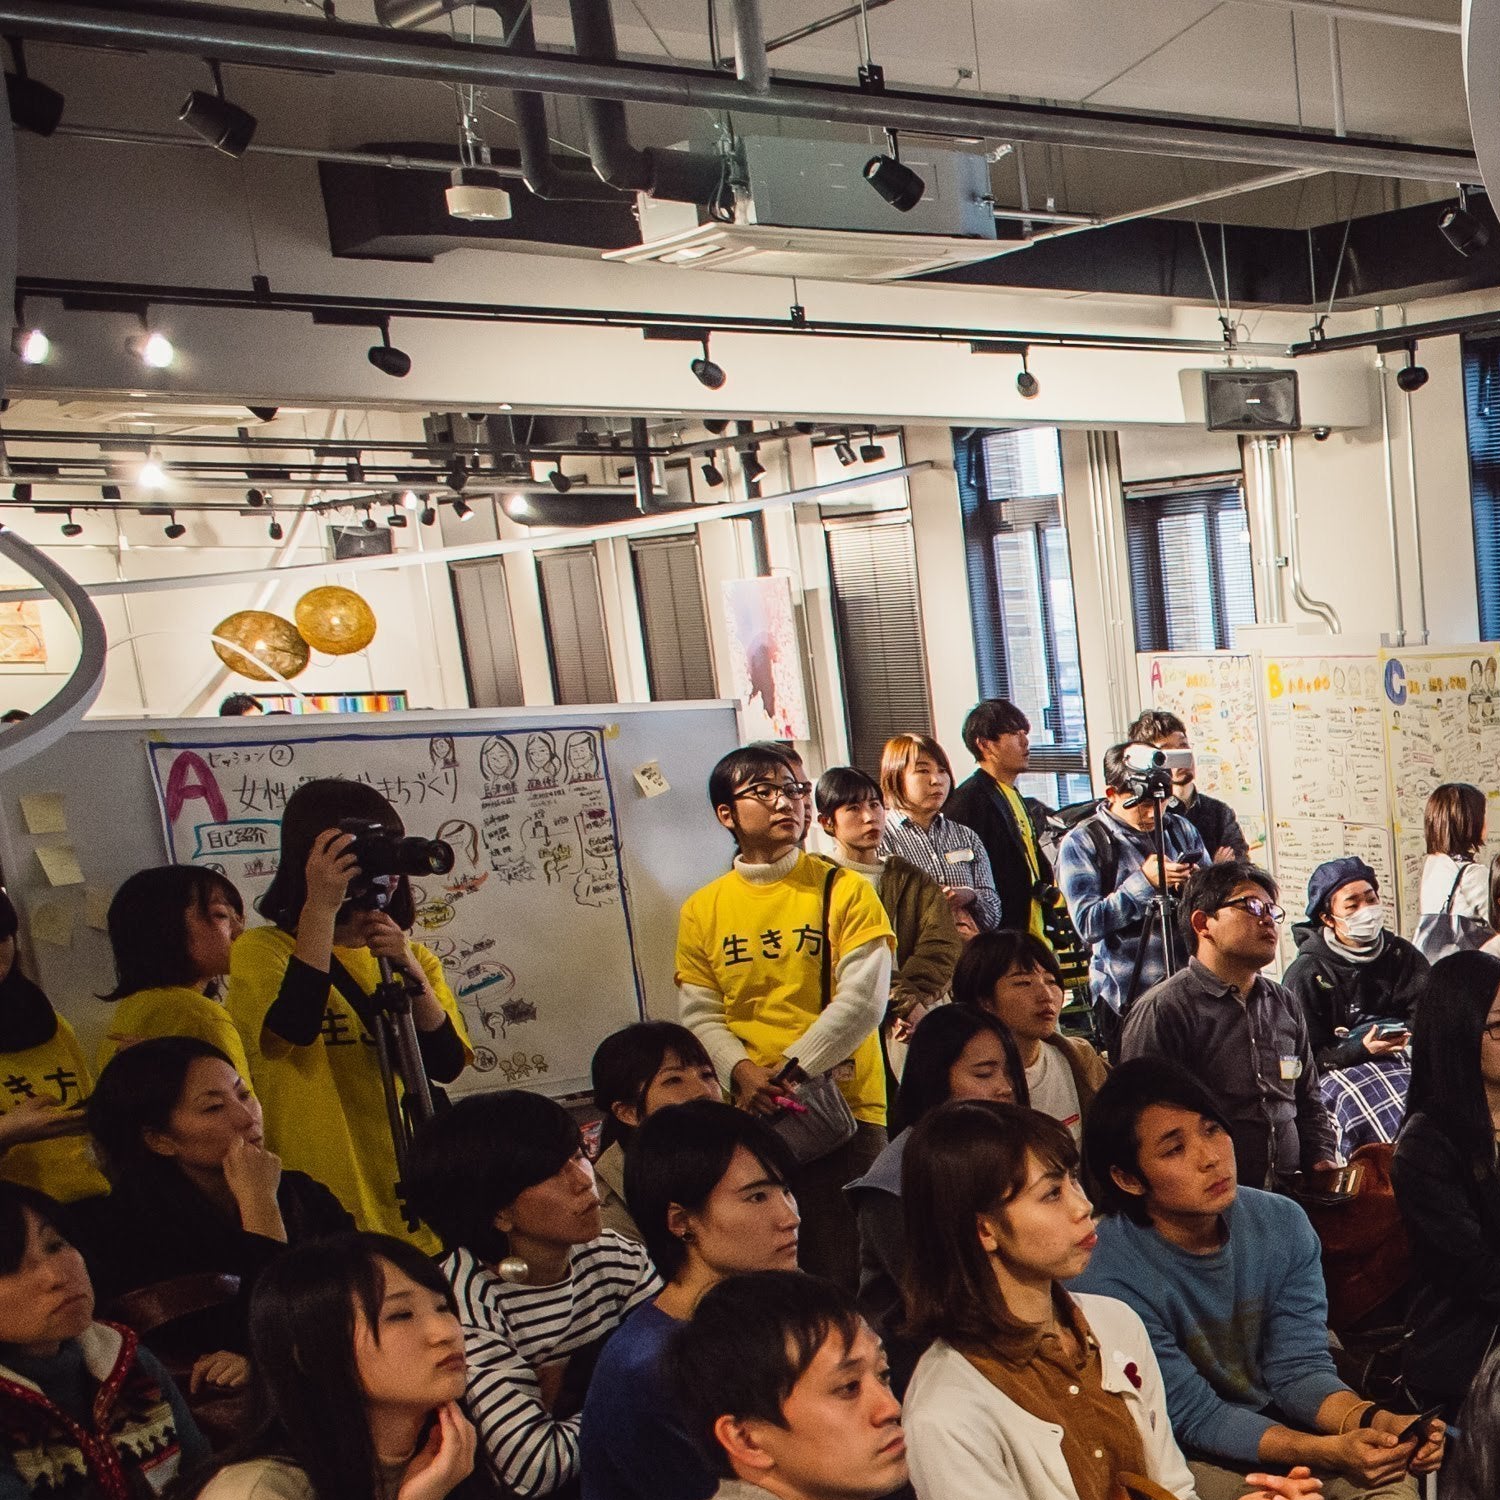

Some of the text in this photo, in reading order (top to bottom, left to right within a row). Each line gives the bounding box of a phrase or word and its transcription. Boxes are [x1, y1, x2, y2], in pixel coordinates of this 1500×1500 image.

[1150, 660, 1163, 689] A
[1267, 663, 1284, 699] B
[1384, 658, 1407, 706] C
[165, 750, 230, 824] A
[206, 826, 269, 849] 自己紹介
[723, 924, 825, 967] 生き方
